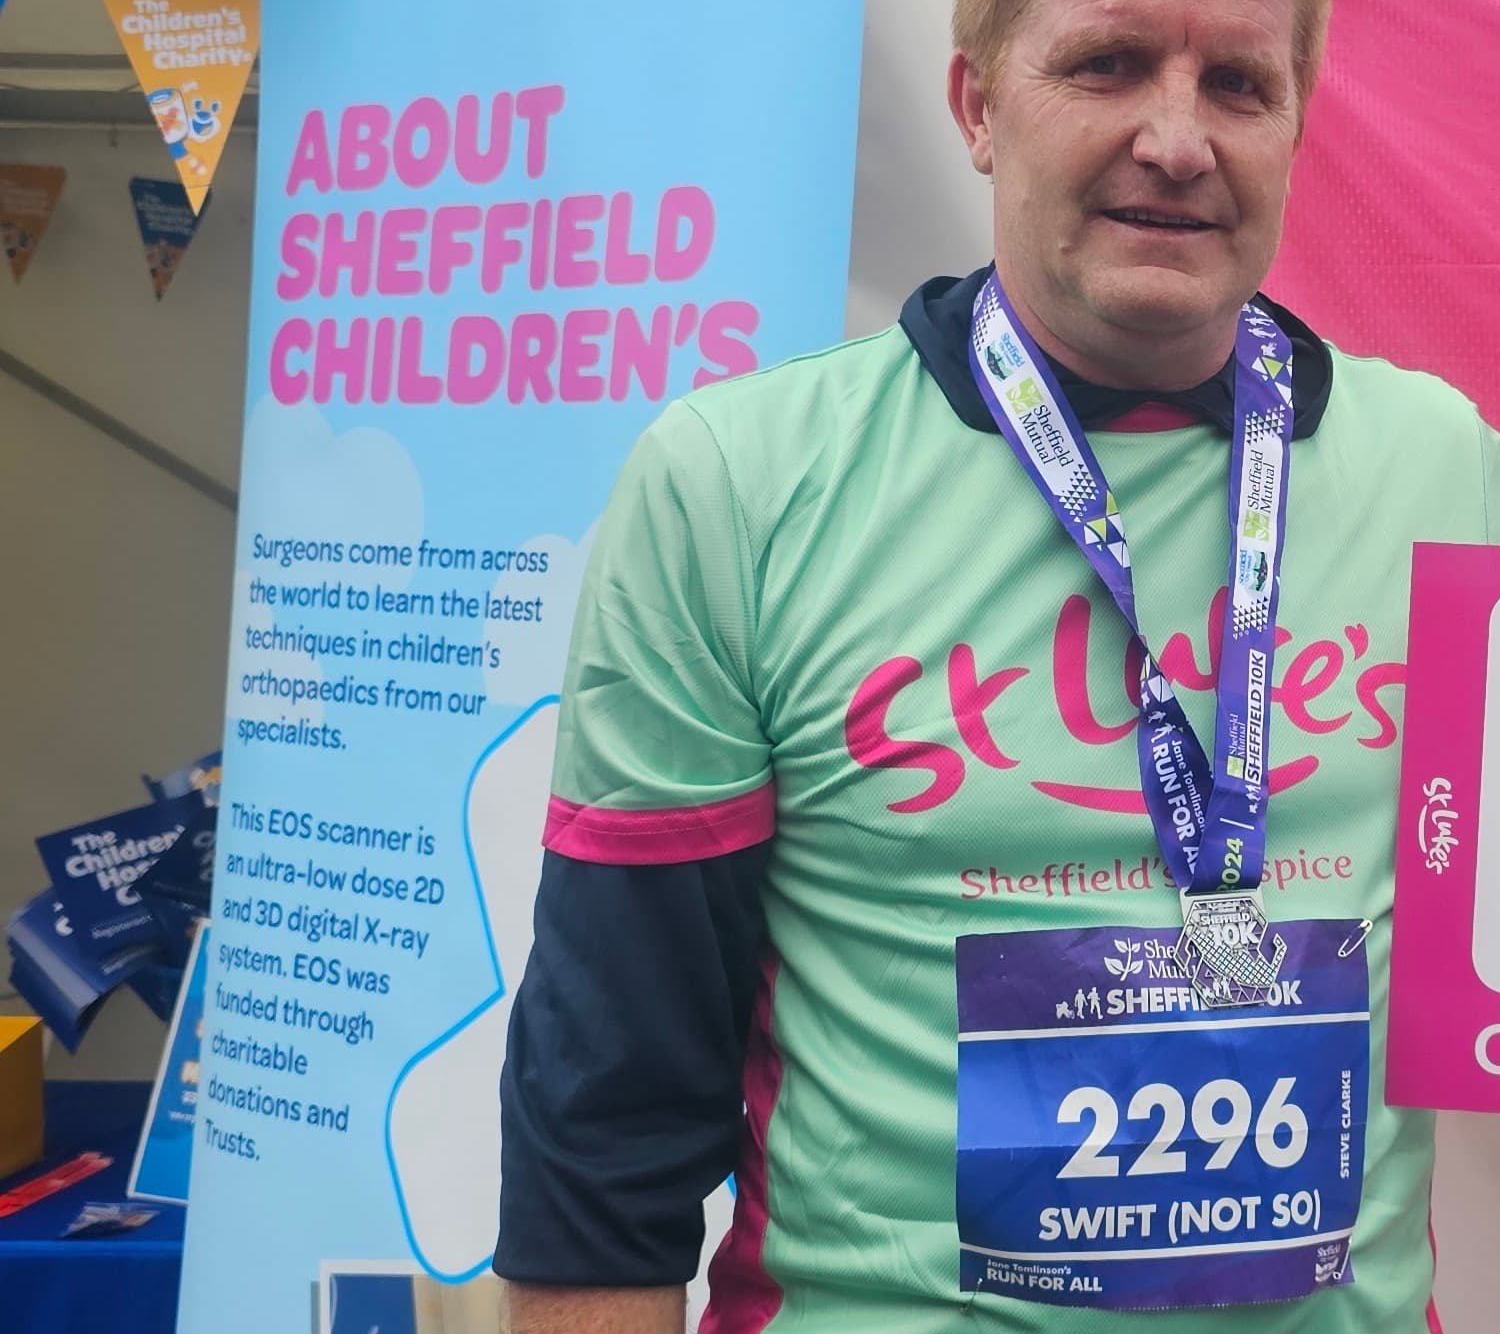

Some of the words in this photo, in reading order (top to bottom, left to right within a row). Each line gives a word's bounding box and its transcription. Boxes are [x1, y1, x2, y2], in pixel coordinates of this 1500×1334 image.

[285, 84, 566, 196] ABOUT
[275, 186, 716, 302] SHEFFIELD
[269, 300, 762, 407] CHILDREN'S
[1019, 411, 1056, 466] Mutual
[1033, 404, 1074, 468] Sheffield
[1248, 449, 1264, 511] Sheffield
[1260, 461, 1276, 514] Mutual
[252, 533, 344, 568] Surgeons
[349, 544, 413, 567] come
[418, 539, 477, 570] from
[480, 549, 550, 574] across
[249, 576, 277, 605] the
[281, 579, 341, 610] world
[346, 585, 370, 612] to
[375, 584, 435, 616] learn
[440, 589, 480, 619] the
[484, 591, 544, 623] latest
[245, 623, 356, 663] techniques
[361, 629, 382, 659] in
[386, 632, 502, 669] children's
[1250, 653, 1265, 684] 10K
[241, 668, 379, 707] orthopaedics
[384, 679, 443, 713] from
[447, 689, 487, 716] our
[237, 716, 348, 751] specialists.
[845, 642, 1030, 814] St
[1246, 686, 1263, 783] SHEFFIELD
[1152, 743, 1182, 794] RUN
[1167, 792, 1196, 842] FOR
[1171, 739, 1187, 770] Jane
[1182, 770, 1205, 833] Tomlinso
[1422, 777, 1453, 808] St
[71, 829, 118, 855] The
[230, 802, 265, 836] This
[267, 808, 314, 841] EOS
[316, 819, 413, 853] scanner
[416, 824, 436, 856] is
[1426, 809, 1460, 875] Luke's
[226, 852, 245, 875] an
[246, 853, 347, 892] ultra-low
[351, 867, 409, 901] dose
[413, 875, 446, 907] 2D
[960, 857, 1176, 899] Sheffield's
[1261, 851, 1353, 890] spice
[221, 896, 252, 924] and
[253, 899, 283, 929] 3D
[287, 905, 359, 943] digital
[362, 917, 430, 960] X-ray
[1200, 911, 1251, 926] SHEFFIELD
[1211, 920, 1261, 948] 10K
[218, 940, 289, 978] system.
[293, 952, 342, 986] EOS
[346, 966, 391, 996] was
[1148, 959, 1199, 980] Mutu
[214, 981, 278, 1024] funded
[282, 1003, 375, 1047] through
[1106, 986, 1212, 1016] SHEFFI
[210, 1029, 309, 1076] charitable
[207, 1073, 301, 1122] donations
[306, 1104, 351, 1134] and
[1341, 1069, 1352, 1127] CLARKE
[203, 1117, 262, 1162] Trusts.
[1055, 1076, 1309, 1180] 2296
[1339, 1130, 1350, 1179] STEVE
[1038, 1203, 1157, 1241] SWIFT
[1168, 1195, 1262, 1244] (NOT
[1271, 1188, 1322, 1232] SO)
[986, 1267, 1025, 1287] RUN
[1028, 1271, 1066, 1291] FOR
[1069, 1275, 1103, 1293] ALL
[1012, 1263, 1072, 1276] Tomlinson's
